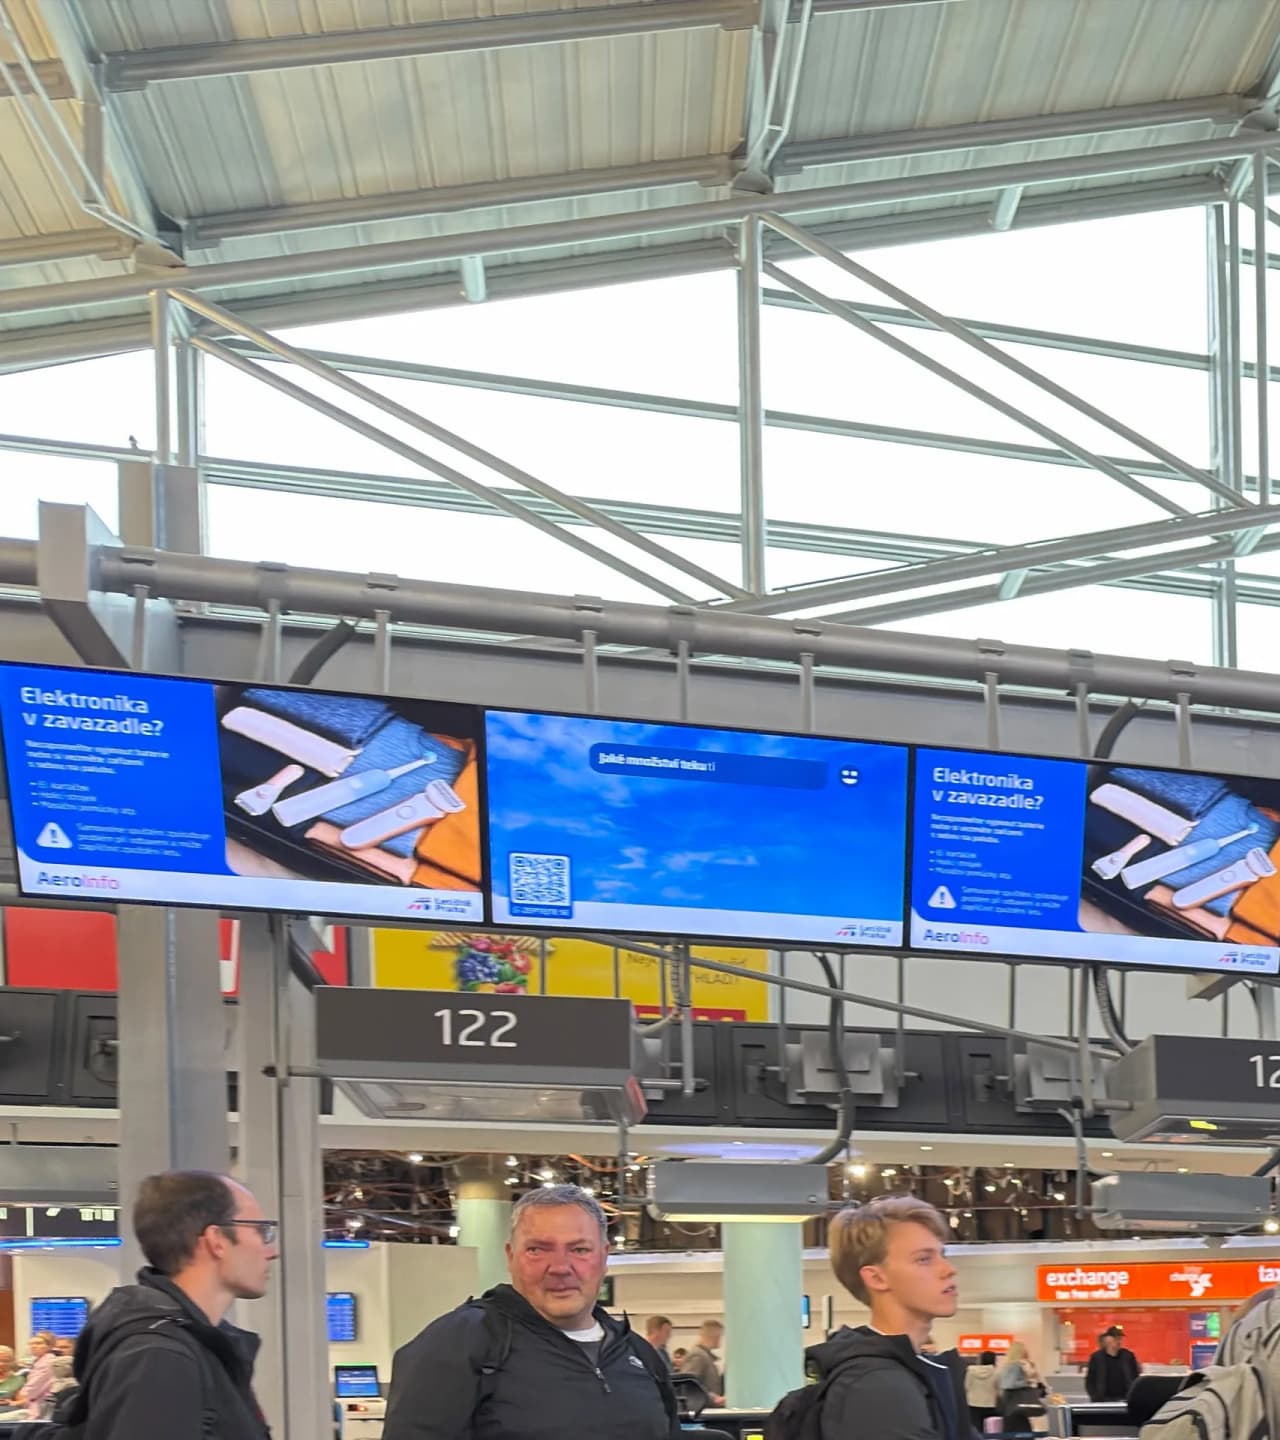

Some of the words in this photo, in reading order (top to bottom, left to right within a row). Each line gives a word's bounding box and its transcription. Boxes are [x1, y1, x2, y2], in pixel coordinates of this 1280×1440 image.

[20, 687, 149, 715] Elektronika
[23, 713, 37, 728] v
[42, 712, 164, 736] zavazadle?
[933, 767, 1034, 790] Elektronika
[932, 790, 942, 802] v
[947, 789, 1043, 810] zavazadle?
[433, 1008, 518, 1049] 122
[1046, 1268, 1129, 1289] exchange
